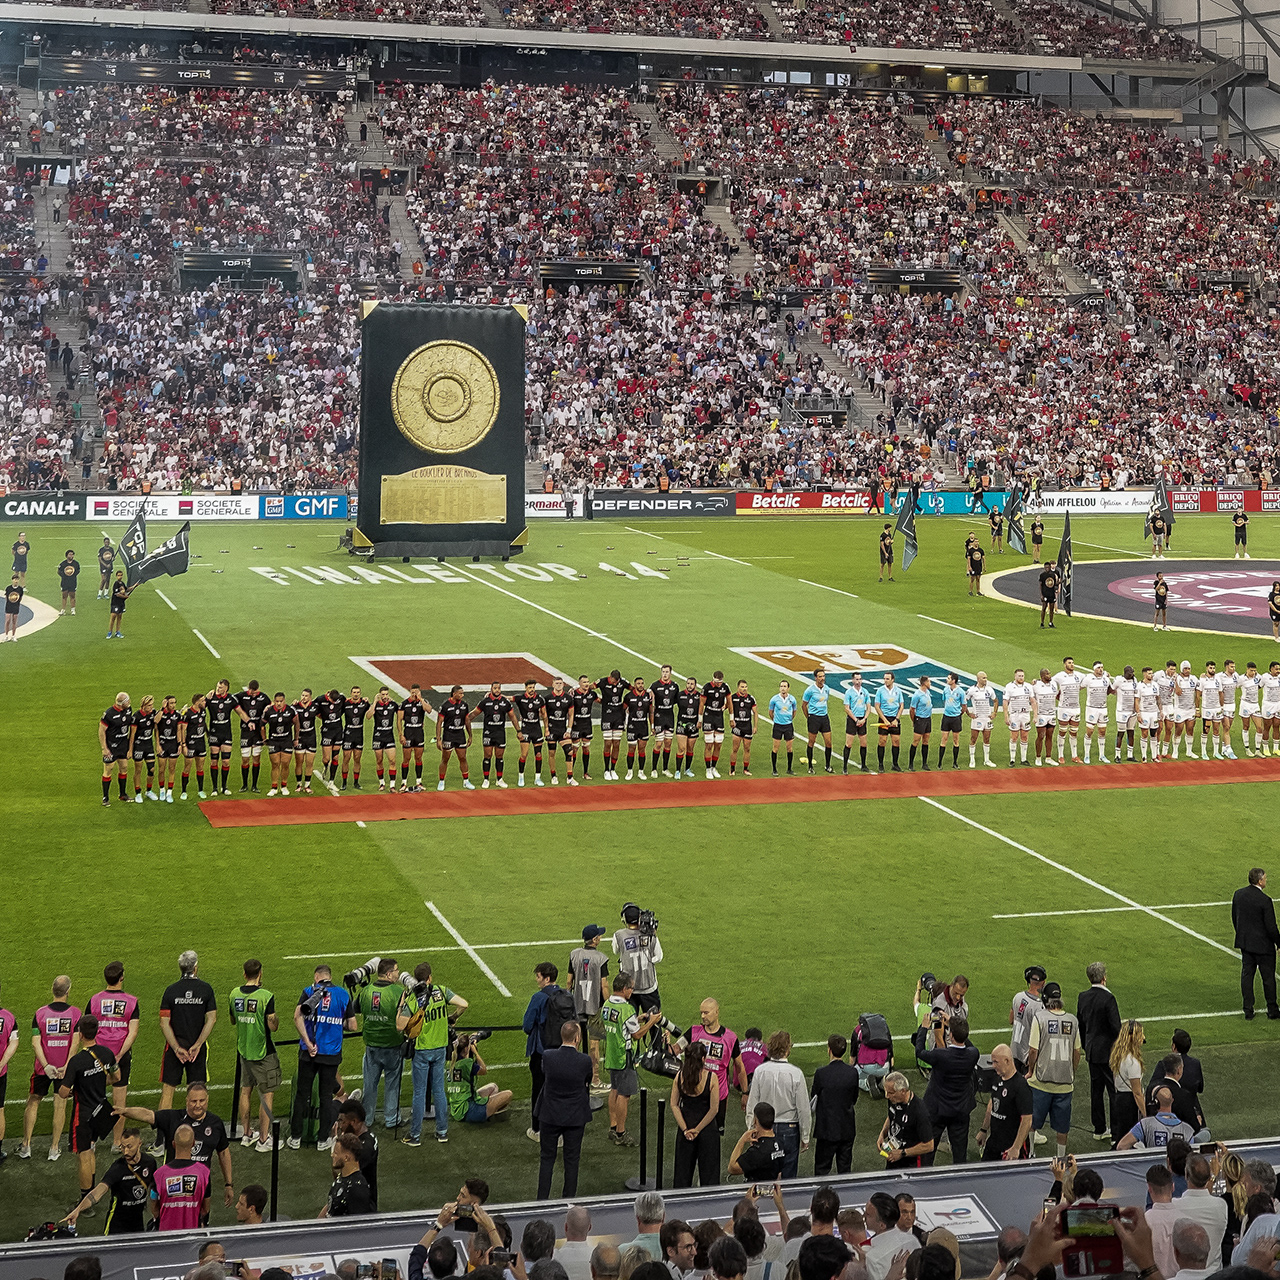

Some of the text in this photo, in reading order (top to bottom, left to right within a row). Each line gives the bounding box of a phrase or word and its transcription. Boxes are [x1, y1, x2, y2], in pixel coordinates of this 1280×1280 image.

[178, 70, 211, 78] TOP14
[222, 258, 251, 267] TOP14
[575, 266, 603, 275] TOP14
[900, 273, 926, 281] TOP14
[821, 493, 870, 507] Betclic
[1174, 492, 1198, 500] BRICO
[1218, 492, 1242, 500] BRICO
[592, 500, 692, 510] DEFENDER
[752, 494, 801, 508] Betclic
[1057, 498, 1096, 507] AFFLELOU
[4, 500, 80, 516] CANAL+
[295, 497, 338, 515] GMF
[197, 508, 251, 516] GENERALE
[248, 561, 670, 585] FINALE TOP 14
[174, 997, 203, 1005] FIDUCIAL
